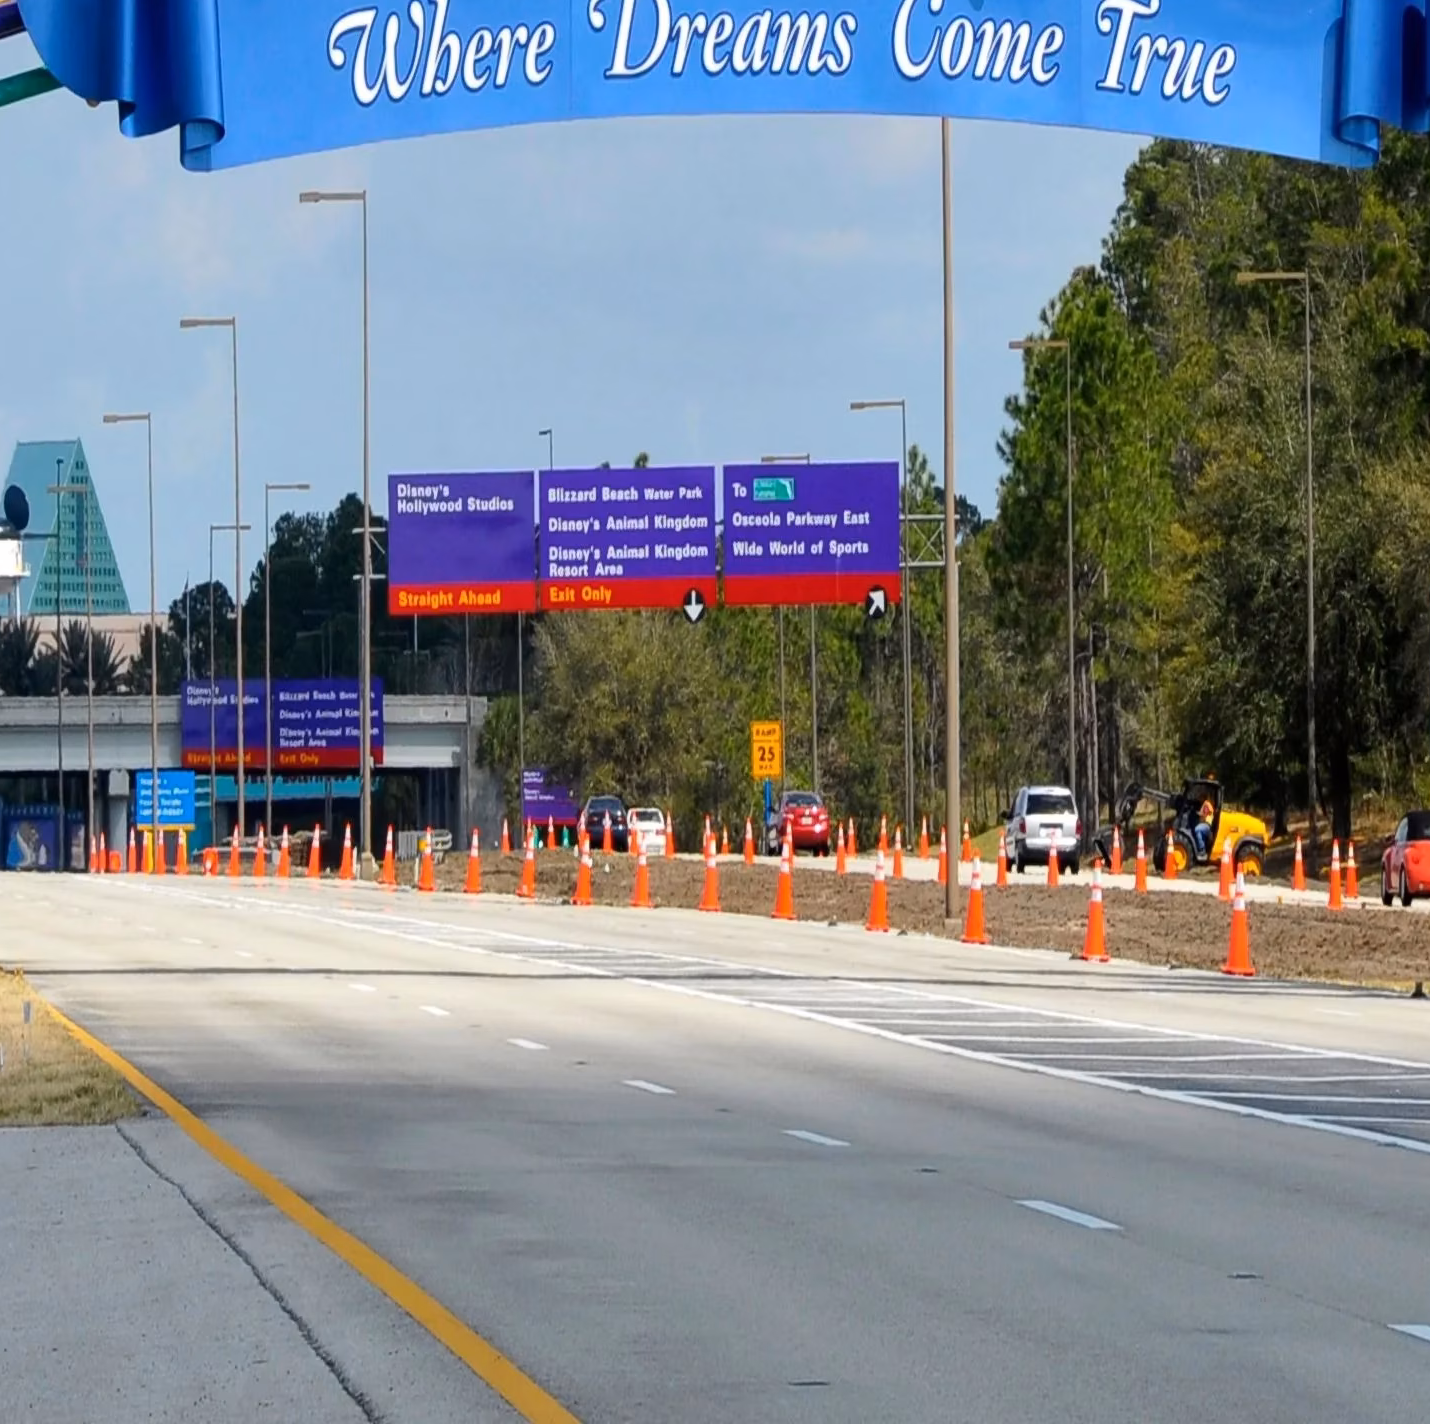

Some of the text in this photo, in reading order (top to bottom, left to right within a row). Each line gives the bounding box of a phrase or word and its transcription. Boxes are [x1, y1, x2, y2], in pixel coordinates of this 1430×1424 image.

[397, 483, 450, 500] Disney's
[548, 486, 703, 502] Blizzard Beach Water Park
[732, 482, 747, 498] To
[397, 496, 514, 516] Hollywood Studios
[548, 514, 708, 534] Disney's Animal Kingdom
[732, 510, 870, 528] Osceola Parkway East
[549, 543, 708, 562] Disney's Animal Kingdom
[733, 539, 869, 557] Wide World of Sports
[549, 562, 623, 577] Resort Area
[398, 589, 501, 609] Straight Ahead
[549, 585, 612, 604] Exit Only
[757, 746, 776, 762] 25
